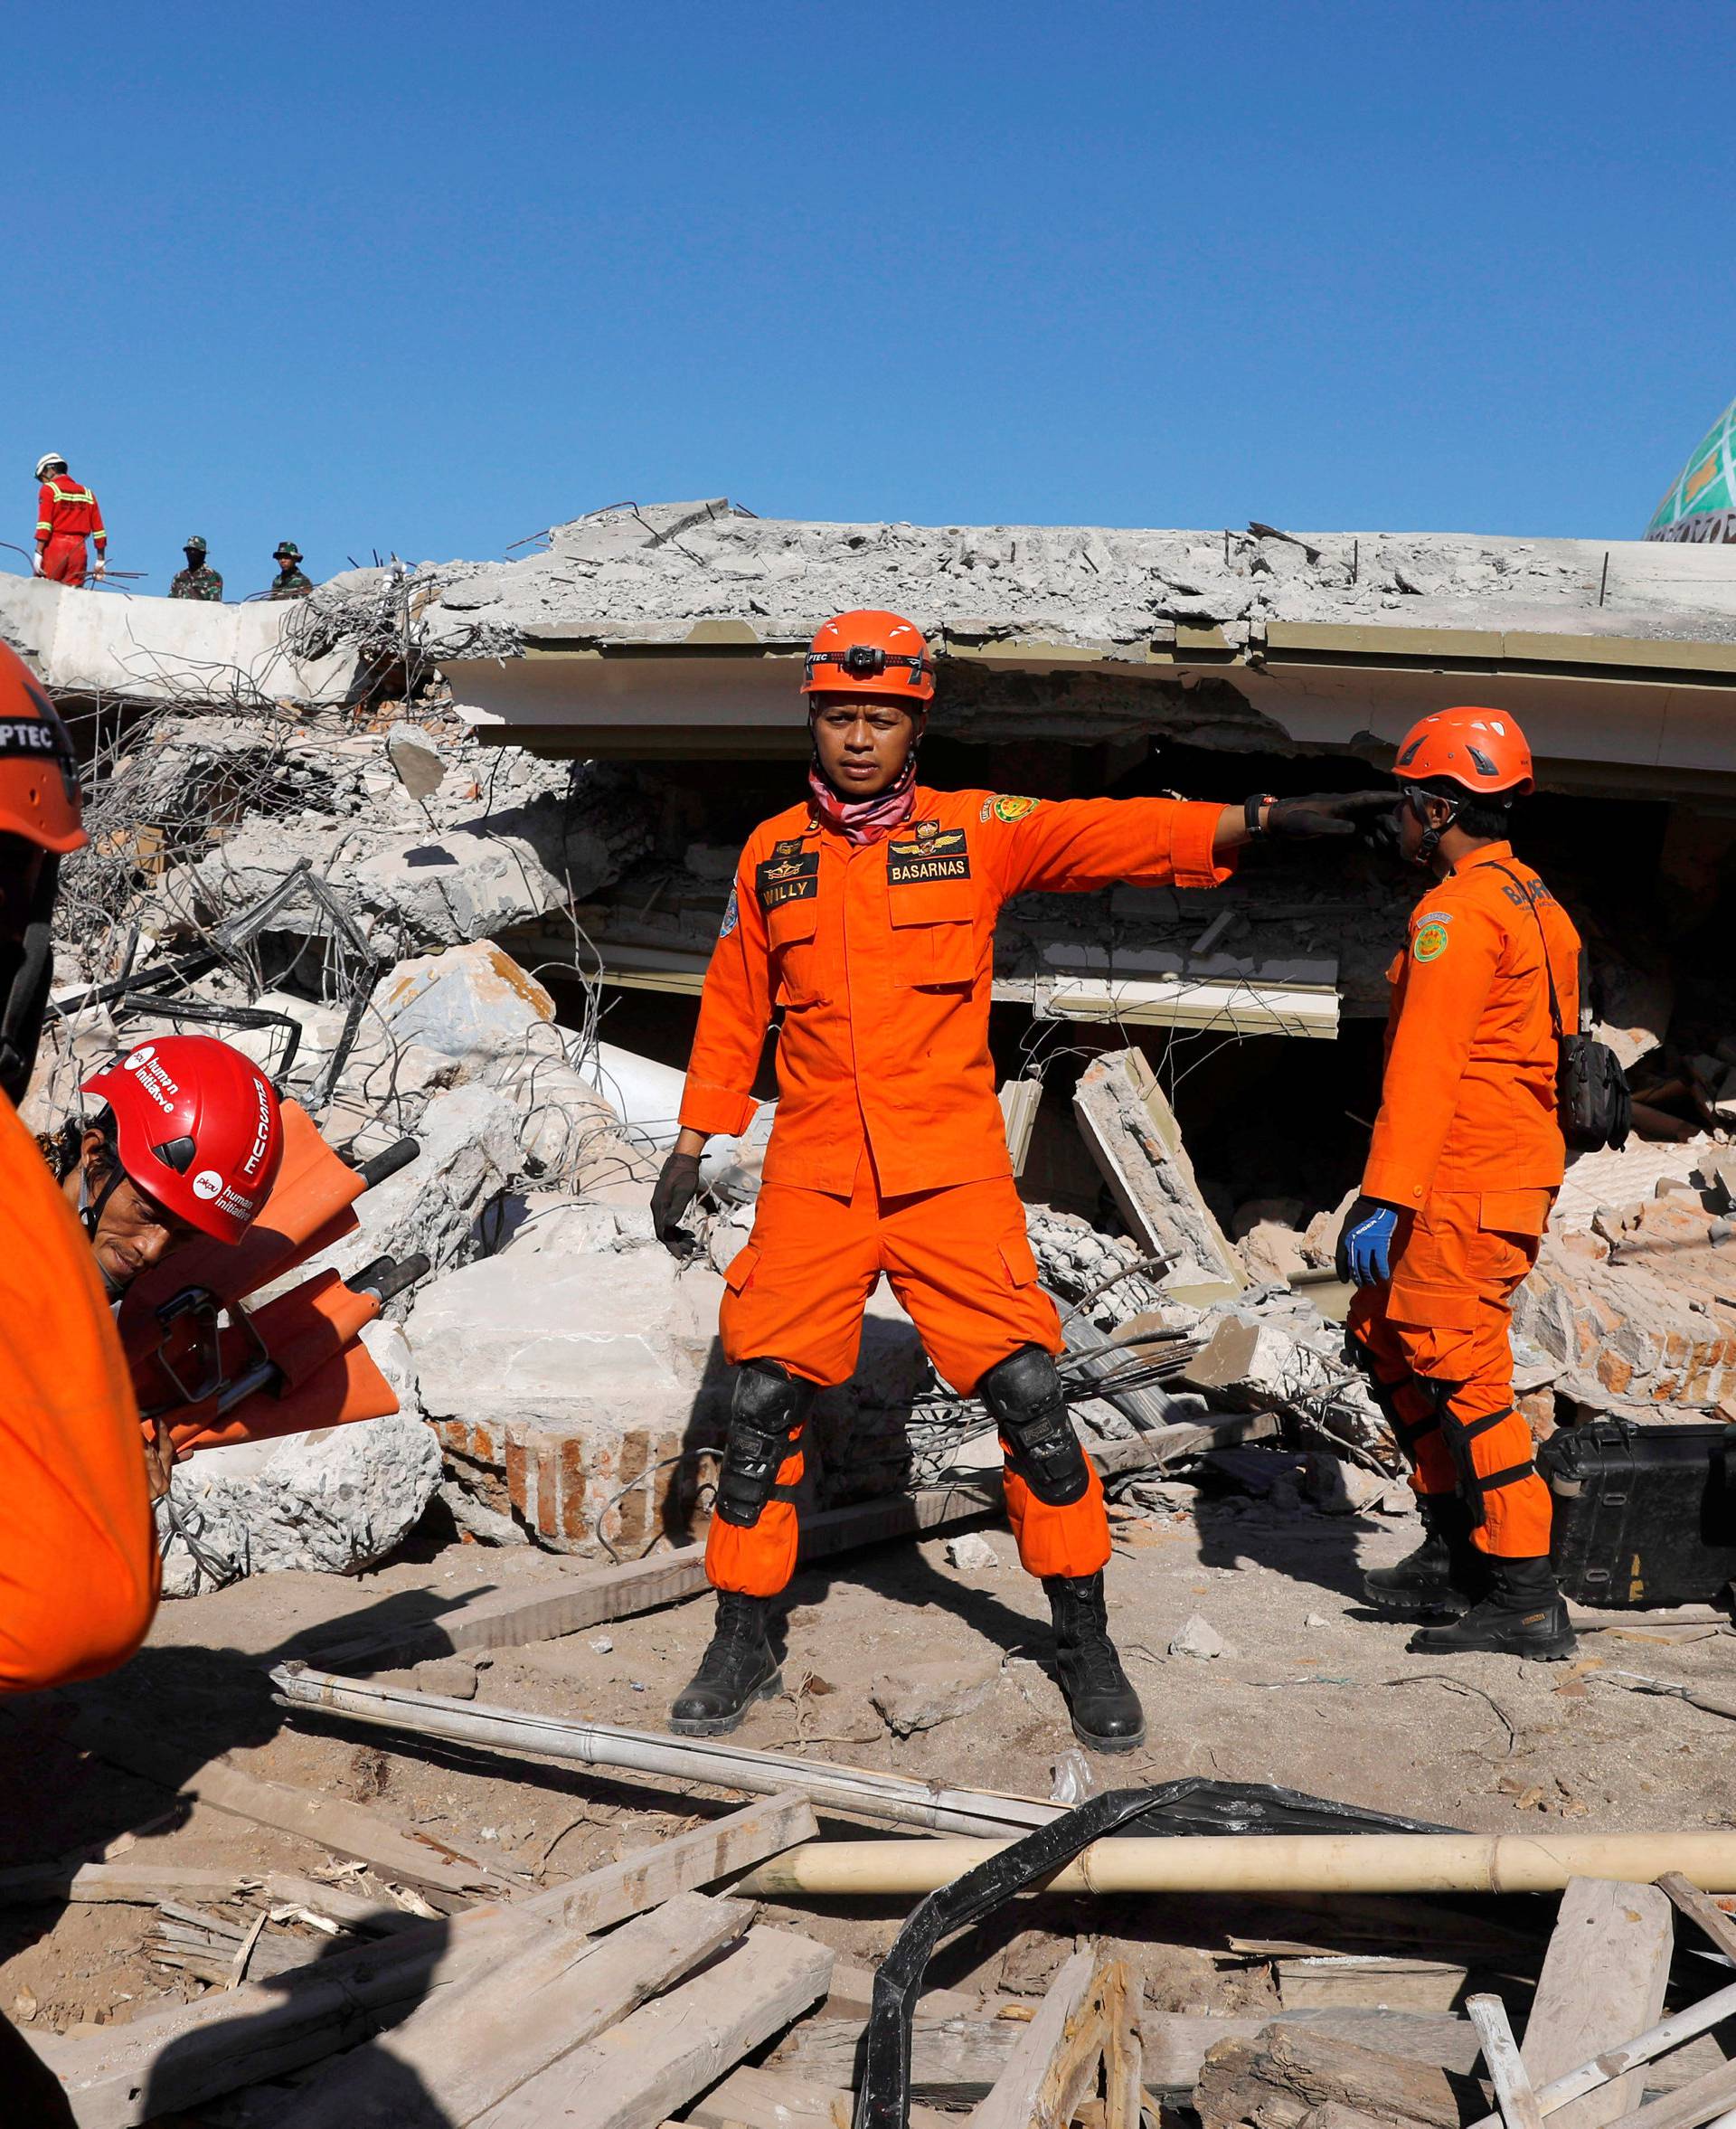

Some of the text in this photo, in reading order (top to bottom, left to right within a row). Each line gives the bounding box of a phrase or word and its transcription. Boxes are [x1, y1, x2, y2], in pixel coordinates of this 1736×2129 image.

[892, 860, 965, 880] BASARNAS
[763, 882, 807, 905] WILLY
[146, 1056, 179, 1095] human
[135, 1065, 175, 1113] initiative
[243, 1077, 269, 1175] RESCUE
[196, 1177, 219, 1193] pkpu
[222, 1185, 253, 1209] human
